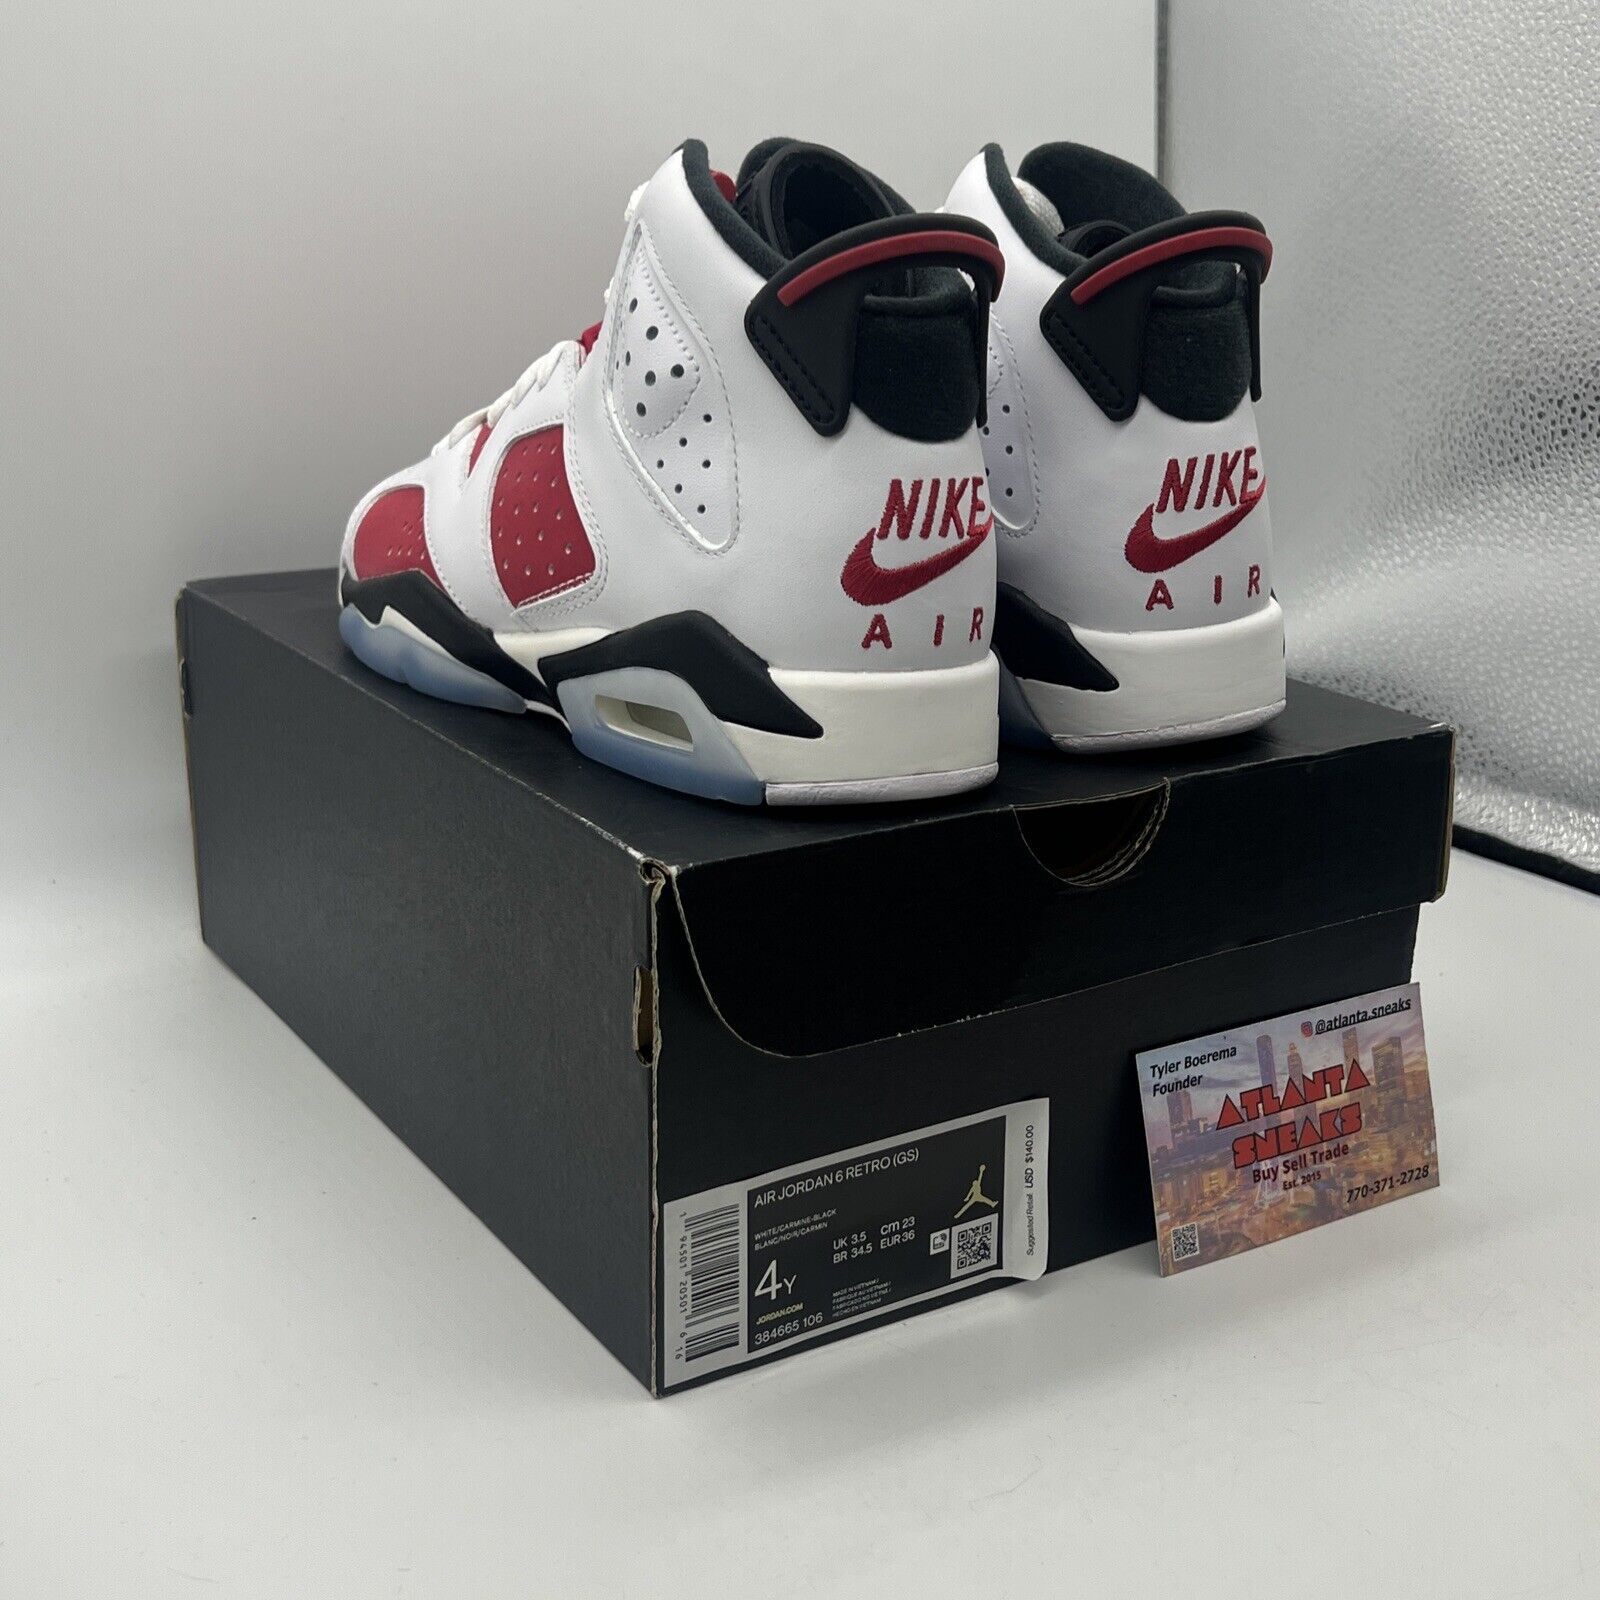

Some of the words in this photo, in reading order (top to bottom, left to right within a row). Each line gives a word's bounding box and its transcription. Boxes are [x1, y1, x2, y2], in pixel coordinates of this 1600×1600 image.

[1155, 446, 1258, 513] NIKE
[876, 476, 986, 540] NIKE
[1315, 998, 1412, 1035] @atlanta.sneaks
[1150, 1060, 1181, 1080] Tyler
[1184, 1046, 1237, 1070] Boerema
[1152, 1074, 1203, 1097] Founder
[1216, 1057, 1371, 1131] ATLANTA
[1025, 1125, 1035, 1163] $140.00
[1232, 1102, 1362, 1170] SNEAKS
[754, 1189, 777, 1208] AIR
[778, 1173, 834, 1201] JORDAN
[835, 1170, 844, 1183] 6
[845, 1156, 891, 1180] RETRO
[893, 1147, 919, 1167] (GS)
[1025, 1167, 1034, 1188] USD
[1253, 1165, 1279, 1184] Buy
[1282, 1153, 1307, 1175] Sell
[1310, 1143, 1349, 1165] Trade
[1282, 1179, 1300, 1191] Est.
[1301, 1171, 1322, 1185] 2015
[1346, 1165, 1430, 1203] 770-371-2728
[1026, 1193, 1034, 1216] Retail
[833, 1236, 848, 1251] UK
[851, 1231, 867, 1245] 3.5
[880, 1221, 900, 1236] cm
[902, 1216, 916, 1230] 23
[833, 1251, 848, 1264] BR
[851, 1243, 873, 1258] 34.5
[880, 1235, 901, 1250] EUR
[901, 1230, 916, 1243] 36
[1026, 1216, 1036, 1256] Suggested
[679, 1235, 688, 1269] 94501
[679, 1280, 688, 1314] 20501
[755, 1302, 804, 1326] JORDAN.COM
[679, 1331, 688, 1339] 6
[754, 1318, 800, 1345] 384665
[803, 1312, 823, 1328] 106
[675, 1346, 683, 1360] 16
